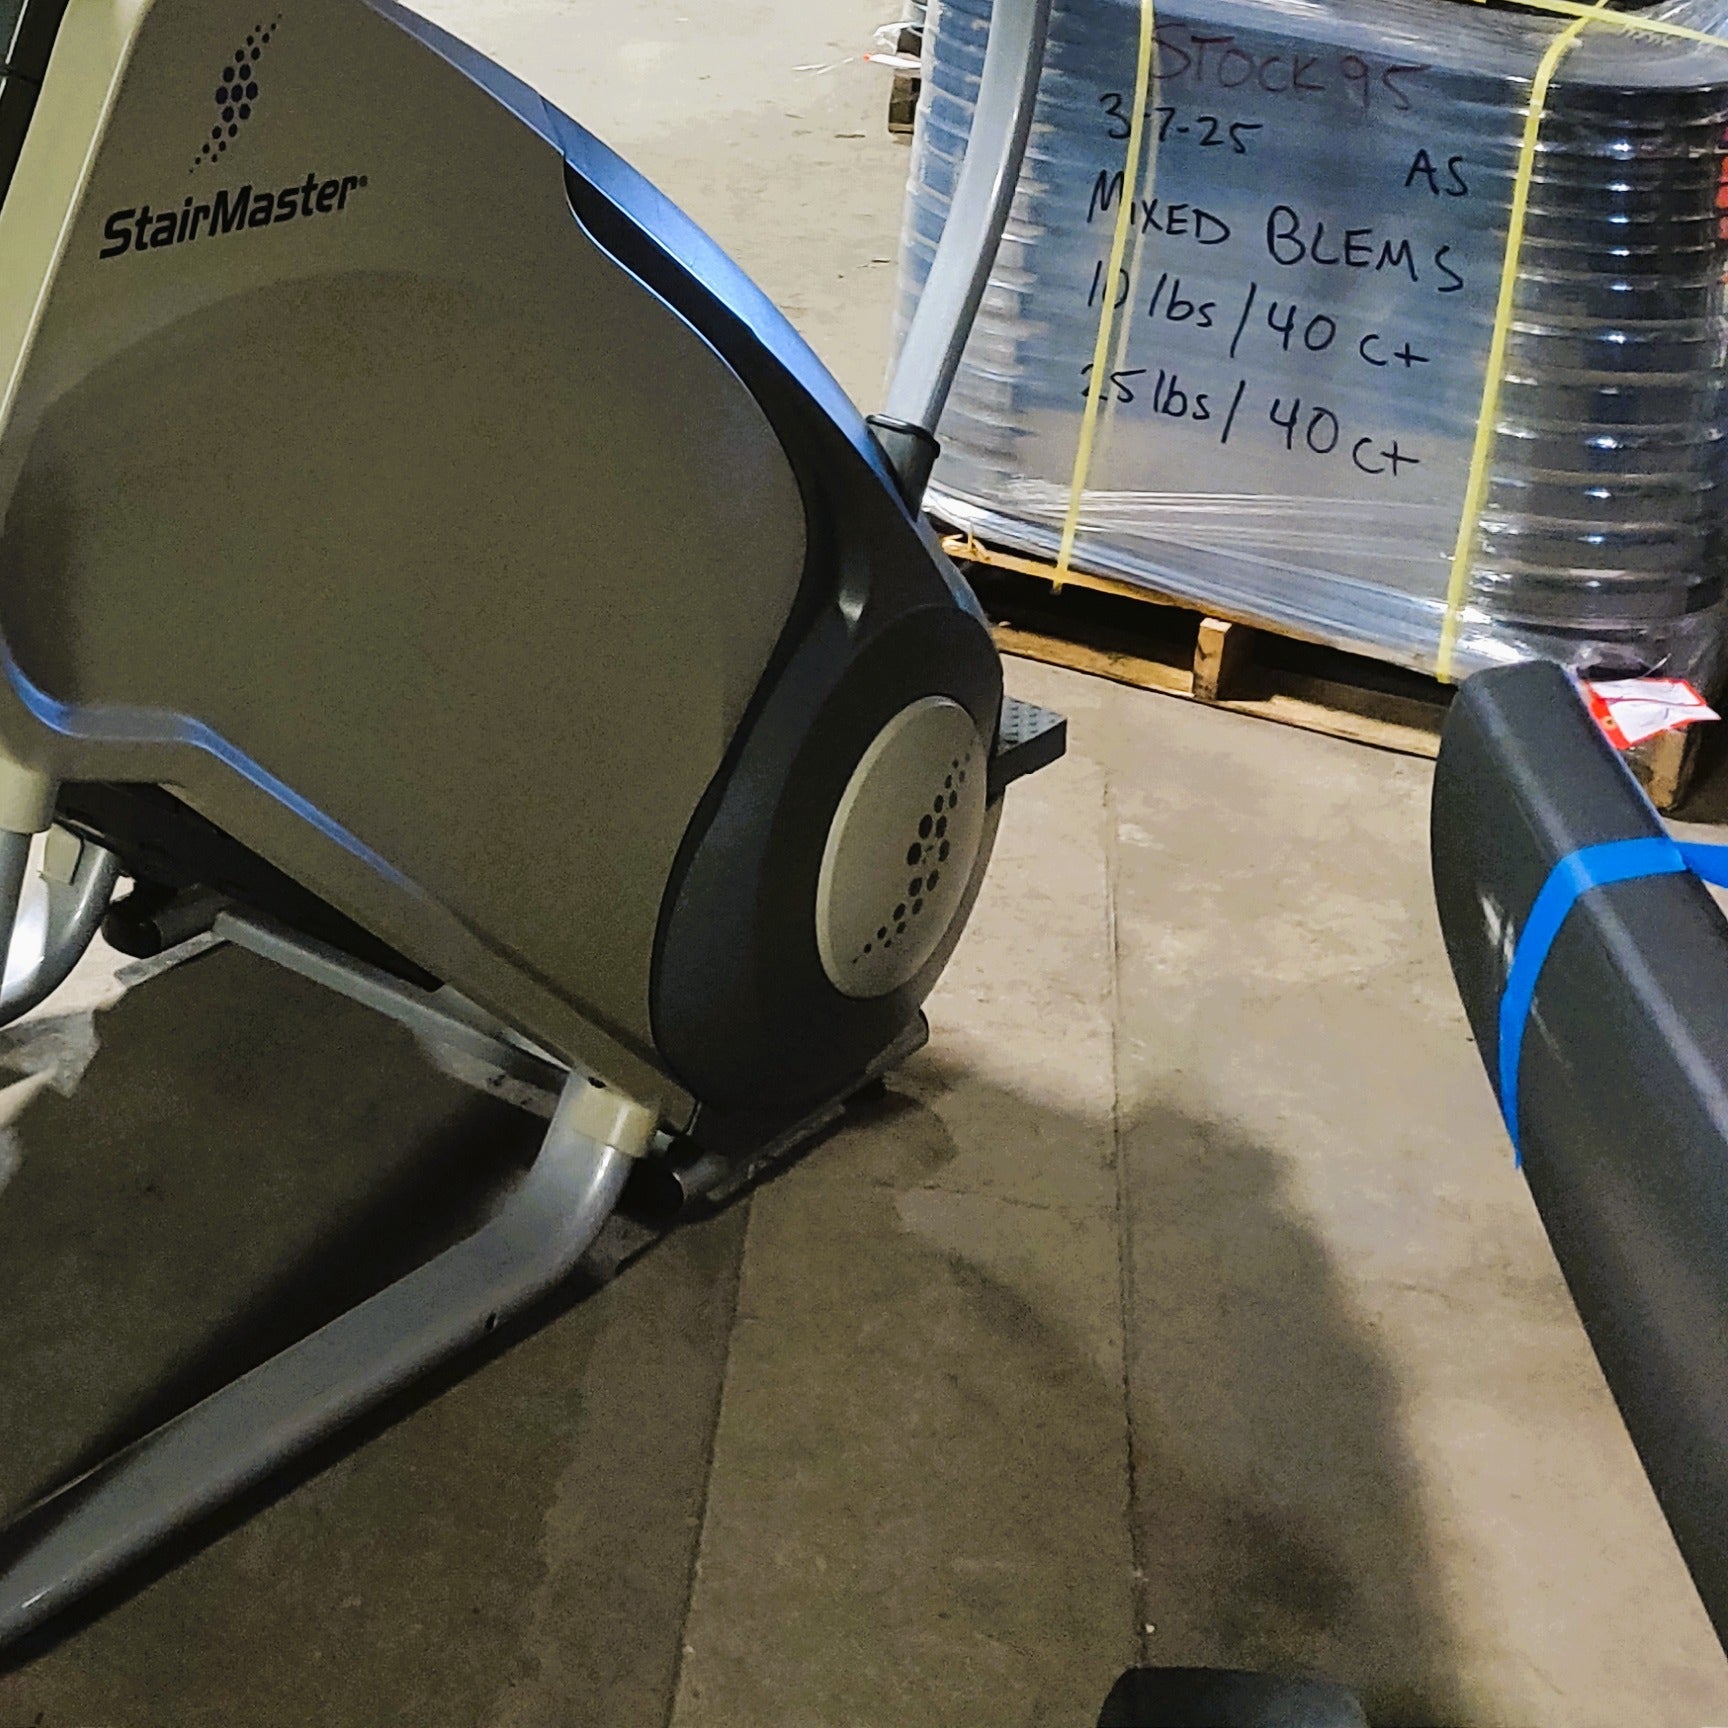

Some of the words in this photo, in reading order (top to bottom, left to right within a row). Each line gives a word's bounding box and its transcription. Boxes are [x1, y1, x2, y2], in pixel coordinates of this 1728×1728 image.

[1151, 22, 1325, 93] STOCK
[1343, 55, 1432, 110] 95
[99, 172, 359, 260] StairMaster
[1404, 148, 1470, 197] AS
[1087, 169, 1231, 245] MIXED
[1266, 204, 1464, 292] BLEMS
